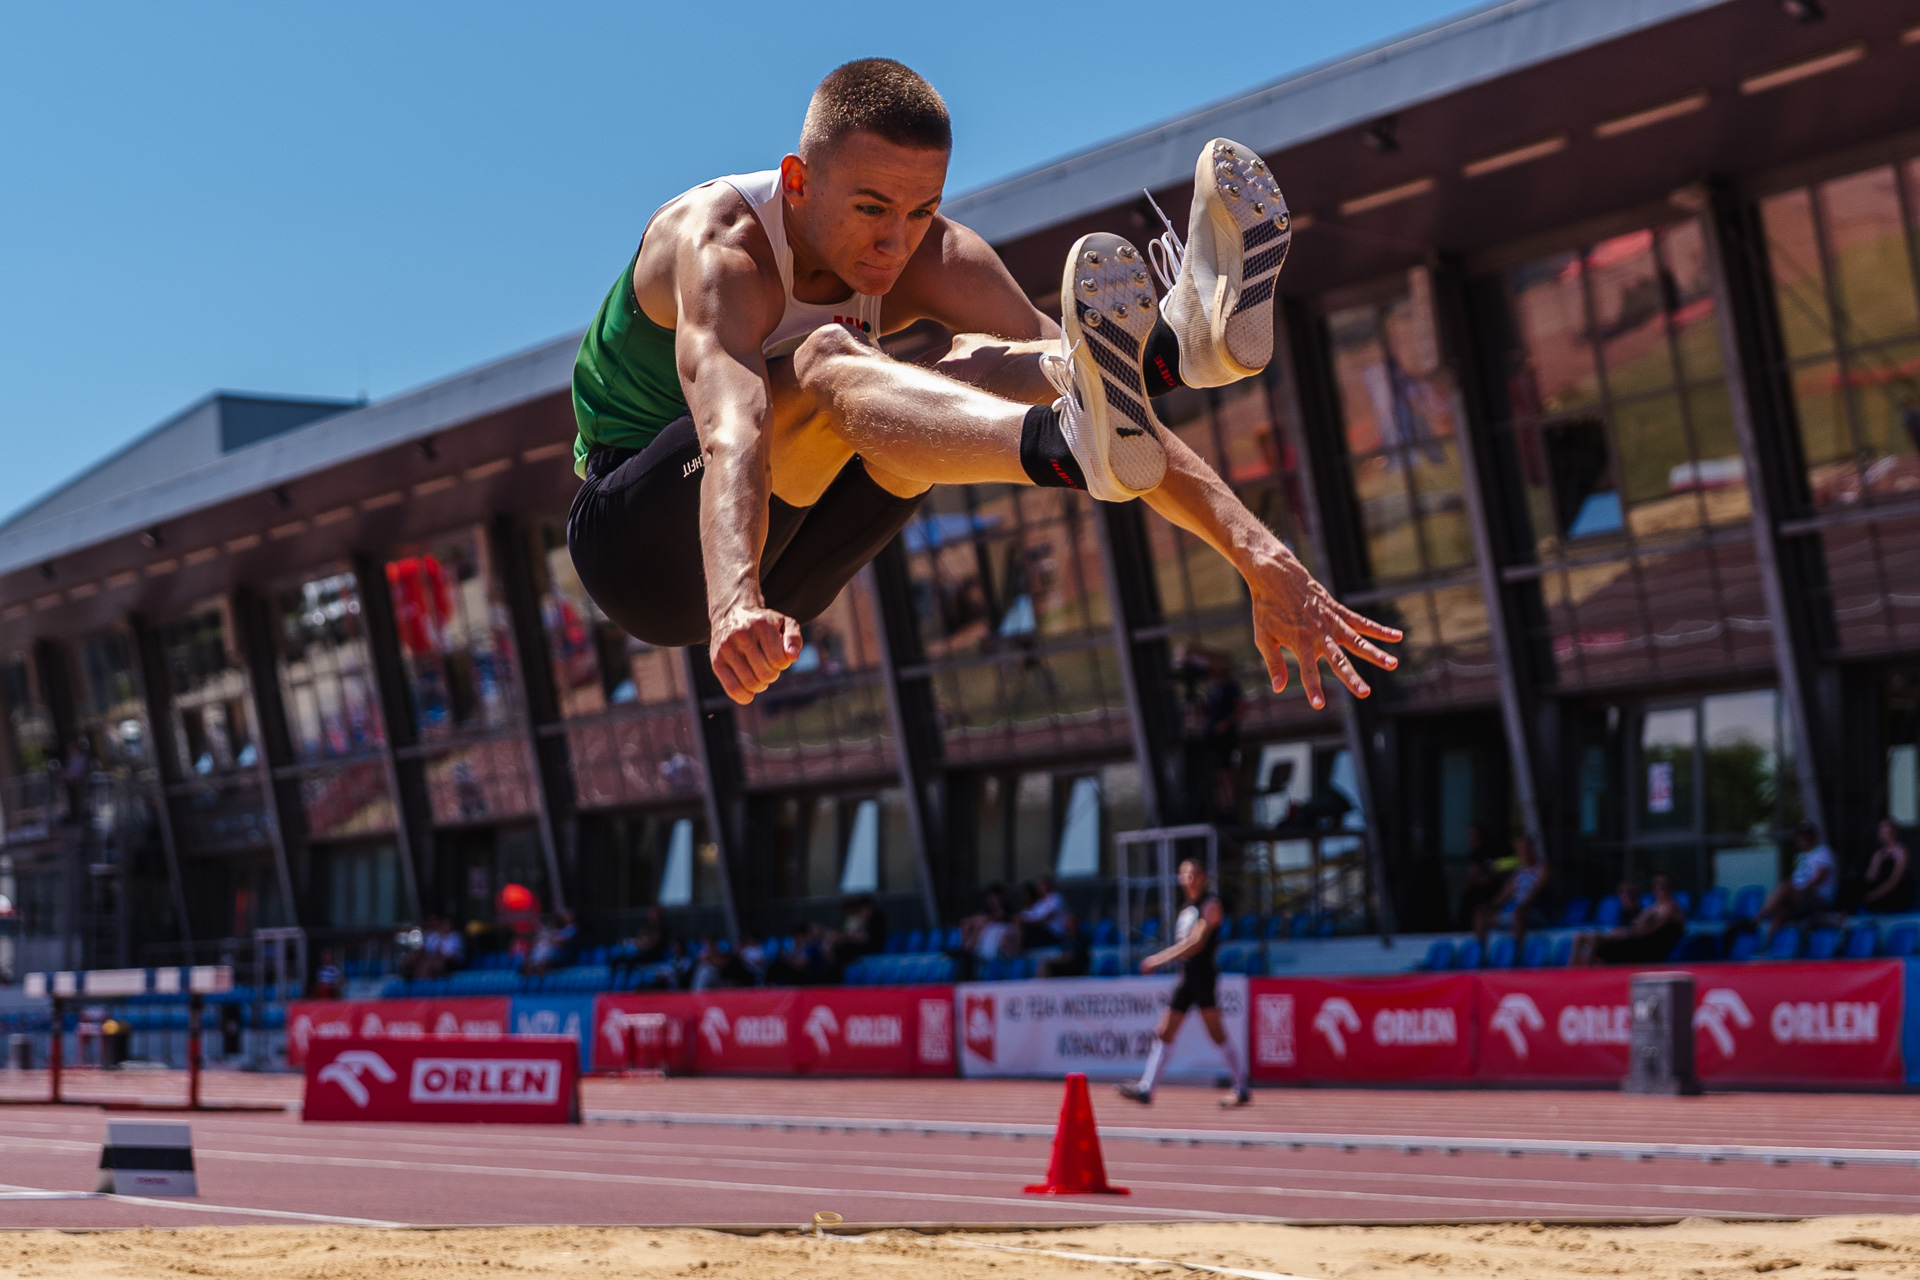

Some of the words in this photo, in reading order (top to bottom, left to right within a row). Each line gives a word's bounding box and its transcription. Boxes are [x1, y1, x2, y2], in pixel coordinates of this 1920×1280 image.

[683, 454, 705, 478] HFIT
[735, 1016, 788, 1046] ORLEN
[846, 1015, 902, 1045] ORLEN
[1373, 1007, 1458, 1046] ORLEN
[1559, 1005, 1632, 1045] ORLE
[1771, 1001, 1879, 1043] ORLEN
[424, 1067, 546, 1095] ORLEN
